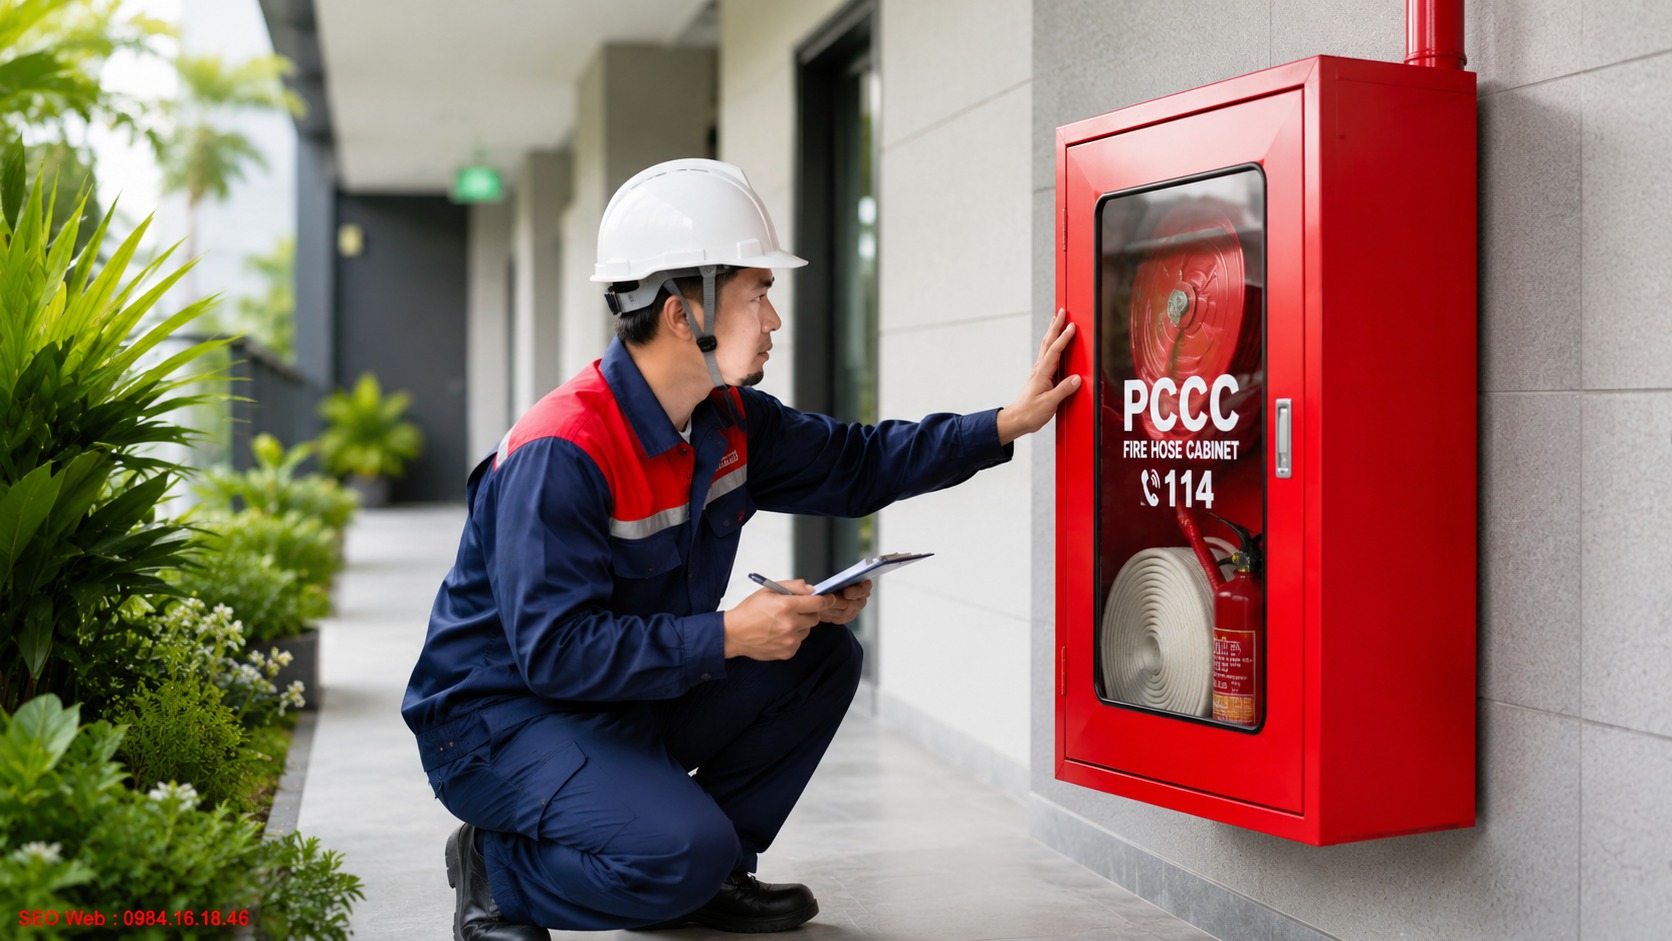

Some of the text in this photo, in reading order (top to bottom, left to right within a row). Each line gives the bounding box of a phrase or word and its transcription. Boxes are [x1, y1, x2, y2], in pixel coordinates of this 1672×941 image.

[1124, 373, 1240, 432] PCCC
[1123, 440, 1240, 460] FIRE HOSE CABINET
[1164, 469, 1214, 509] 114
